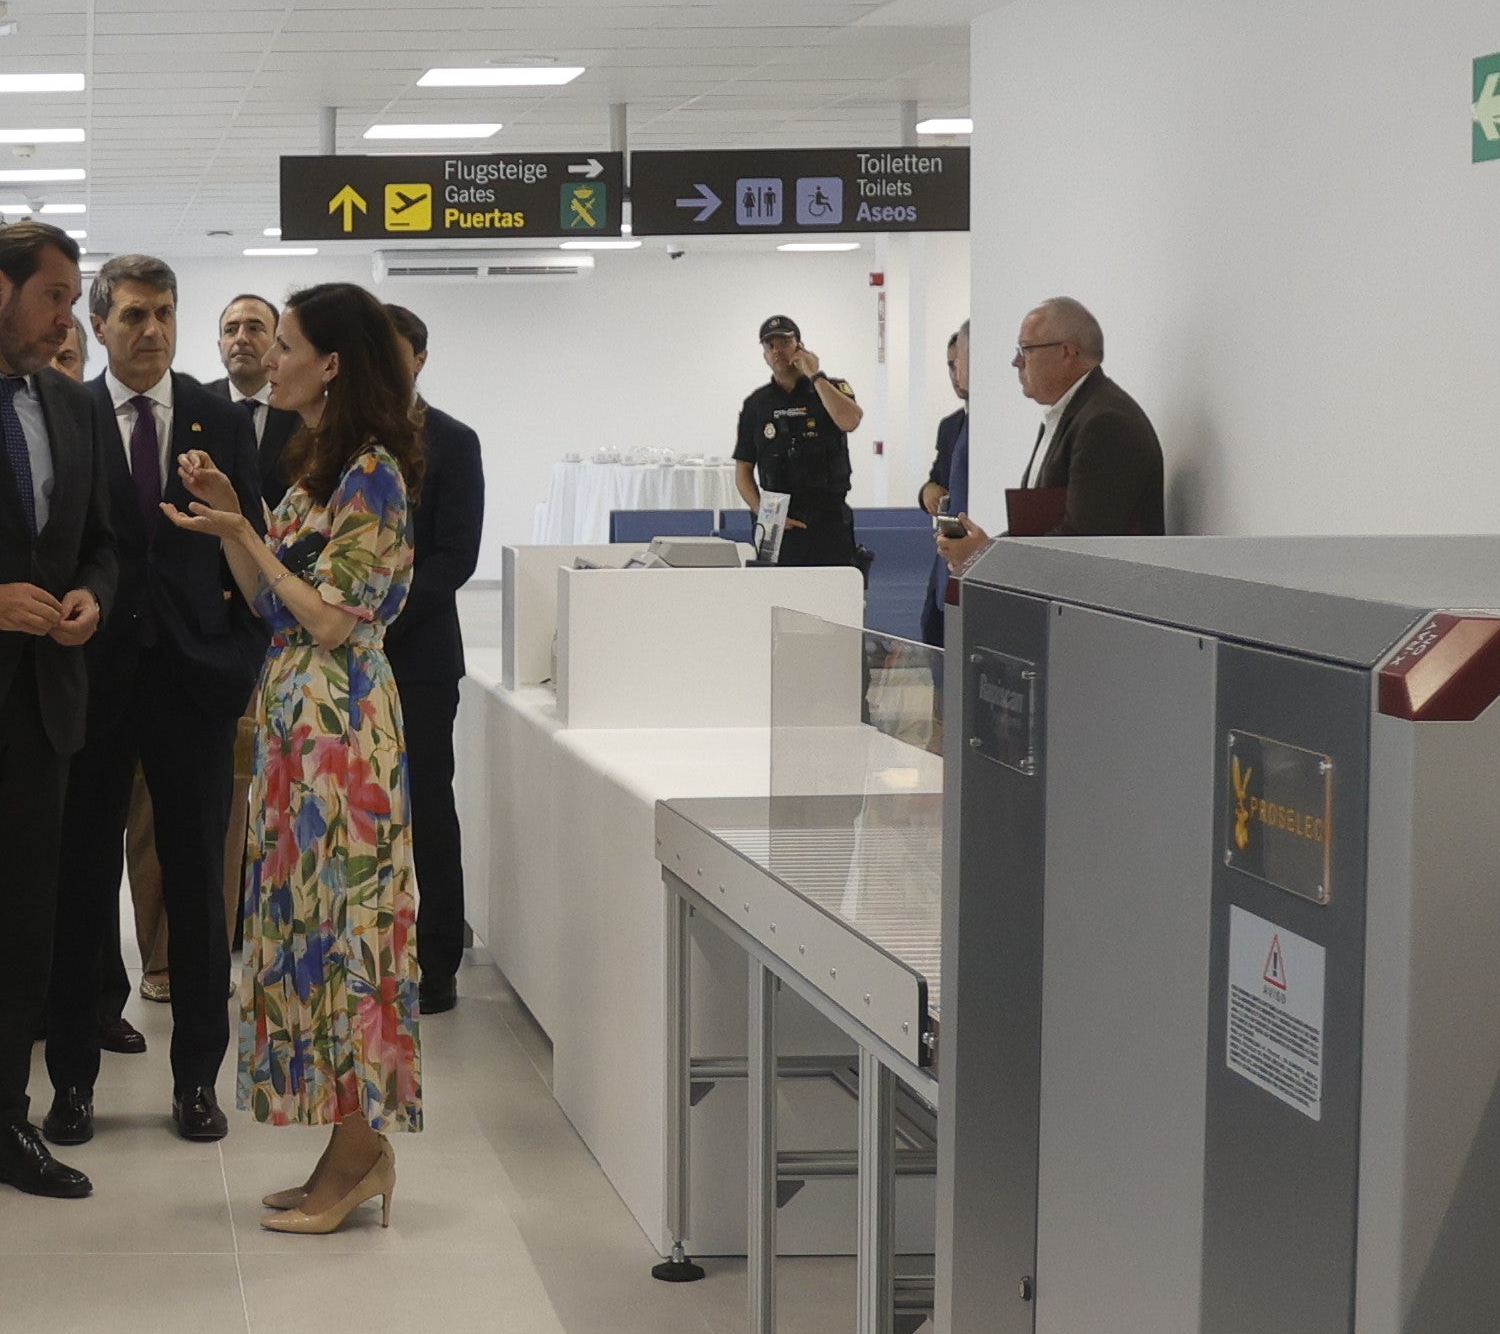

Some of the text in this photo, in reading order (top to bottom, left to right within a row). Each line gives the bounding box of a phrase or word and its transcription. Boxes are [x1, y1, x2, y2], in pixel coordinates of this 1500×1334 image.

[444, 160, 548, 184] Flugsteige
[856, 153, 943, 174] Toiletten
[444, 186, 496, 204] Gates
[856, 178, 913, 197] Toilets
[444, 208, 525, 229] Puertas
[856, 202, 918, 223] Aseos
